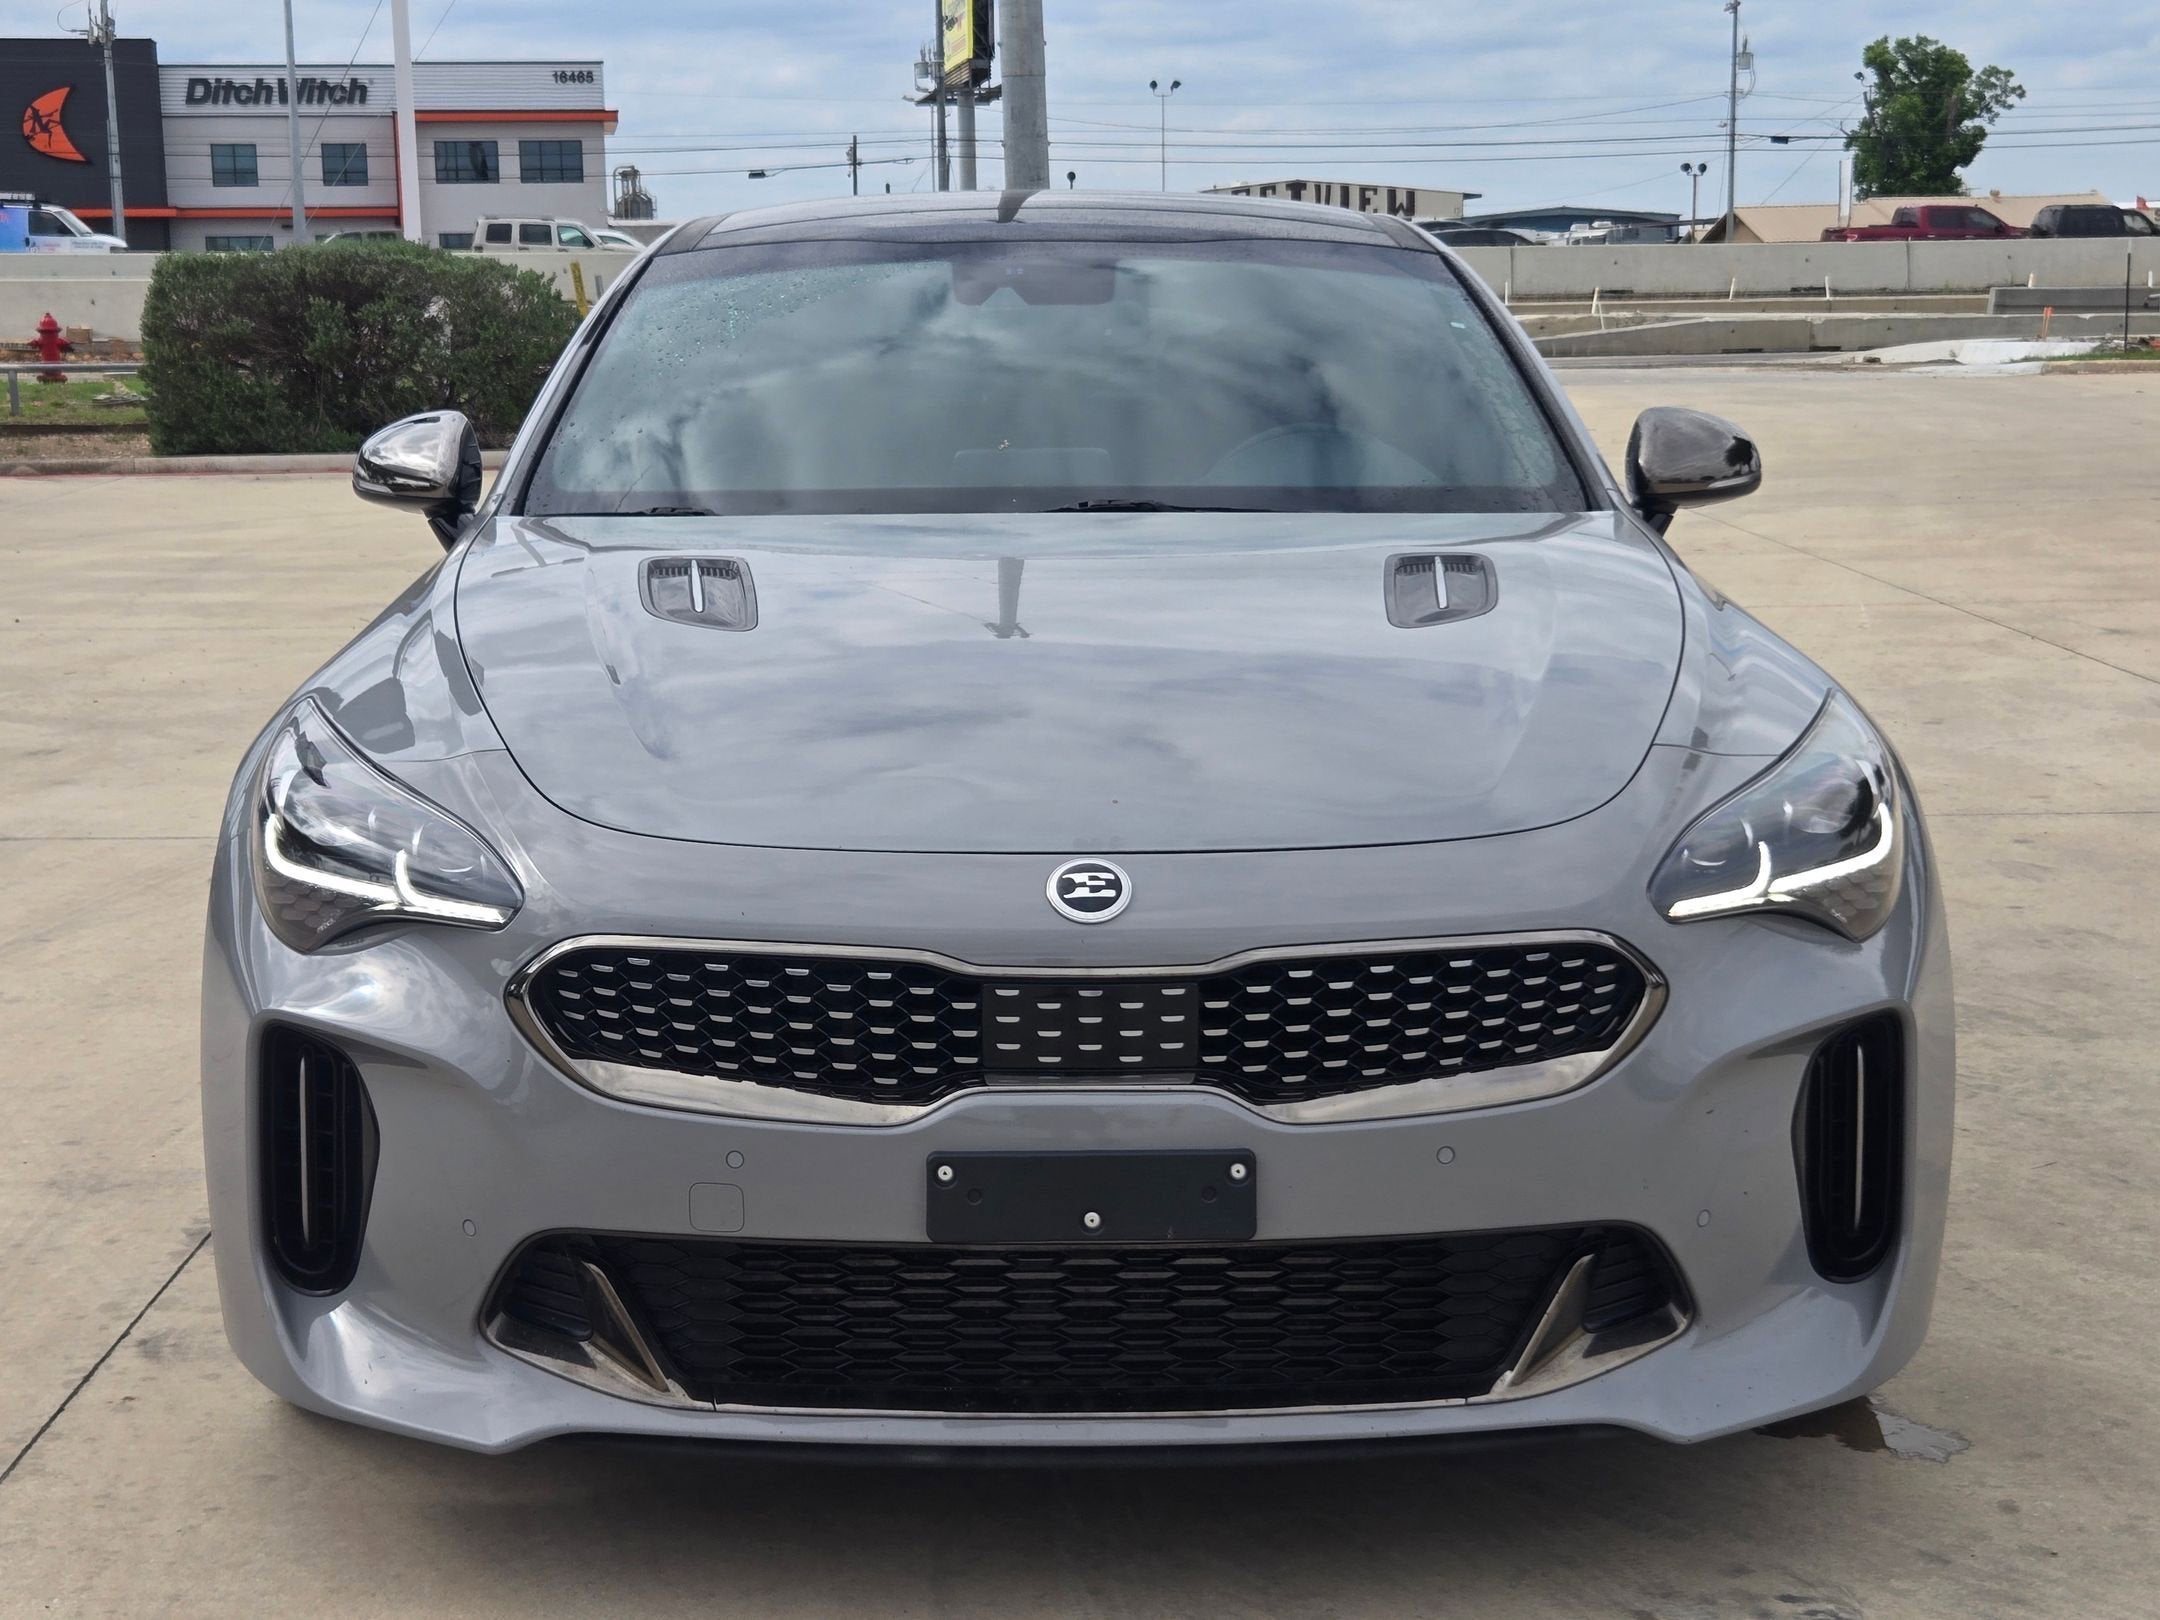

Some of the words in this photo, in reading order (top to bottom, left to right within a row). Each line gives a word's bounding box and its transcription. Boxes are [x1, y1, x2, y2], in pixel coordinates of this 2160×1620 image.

[552, 70, 594, 84] 16465
[185, 78, 274, 105] Ditch
[278, 78, 368, 105] Witch
[1231, 182, 1416, 220] TVIEW
